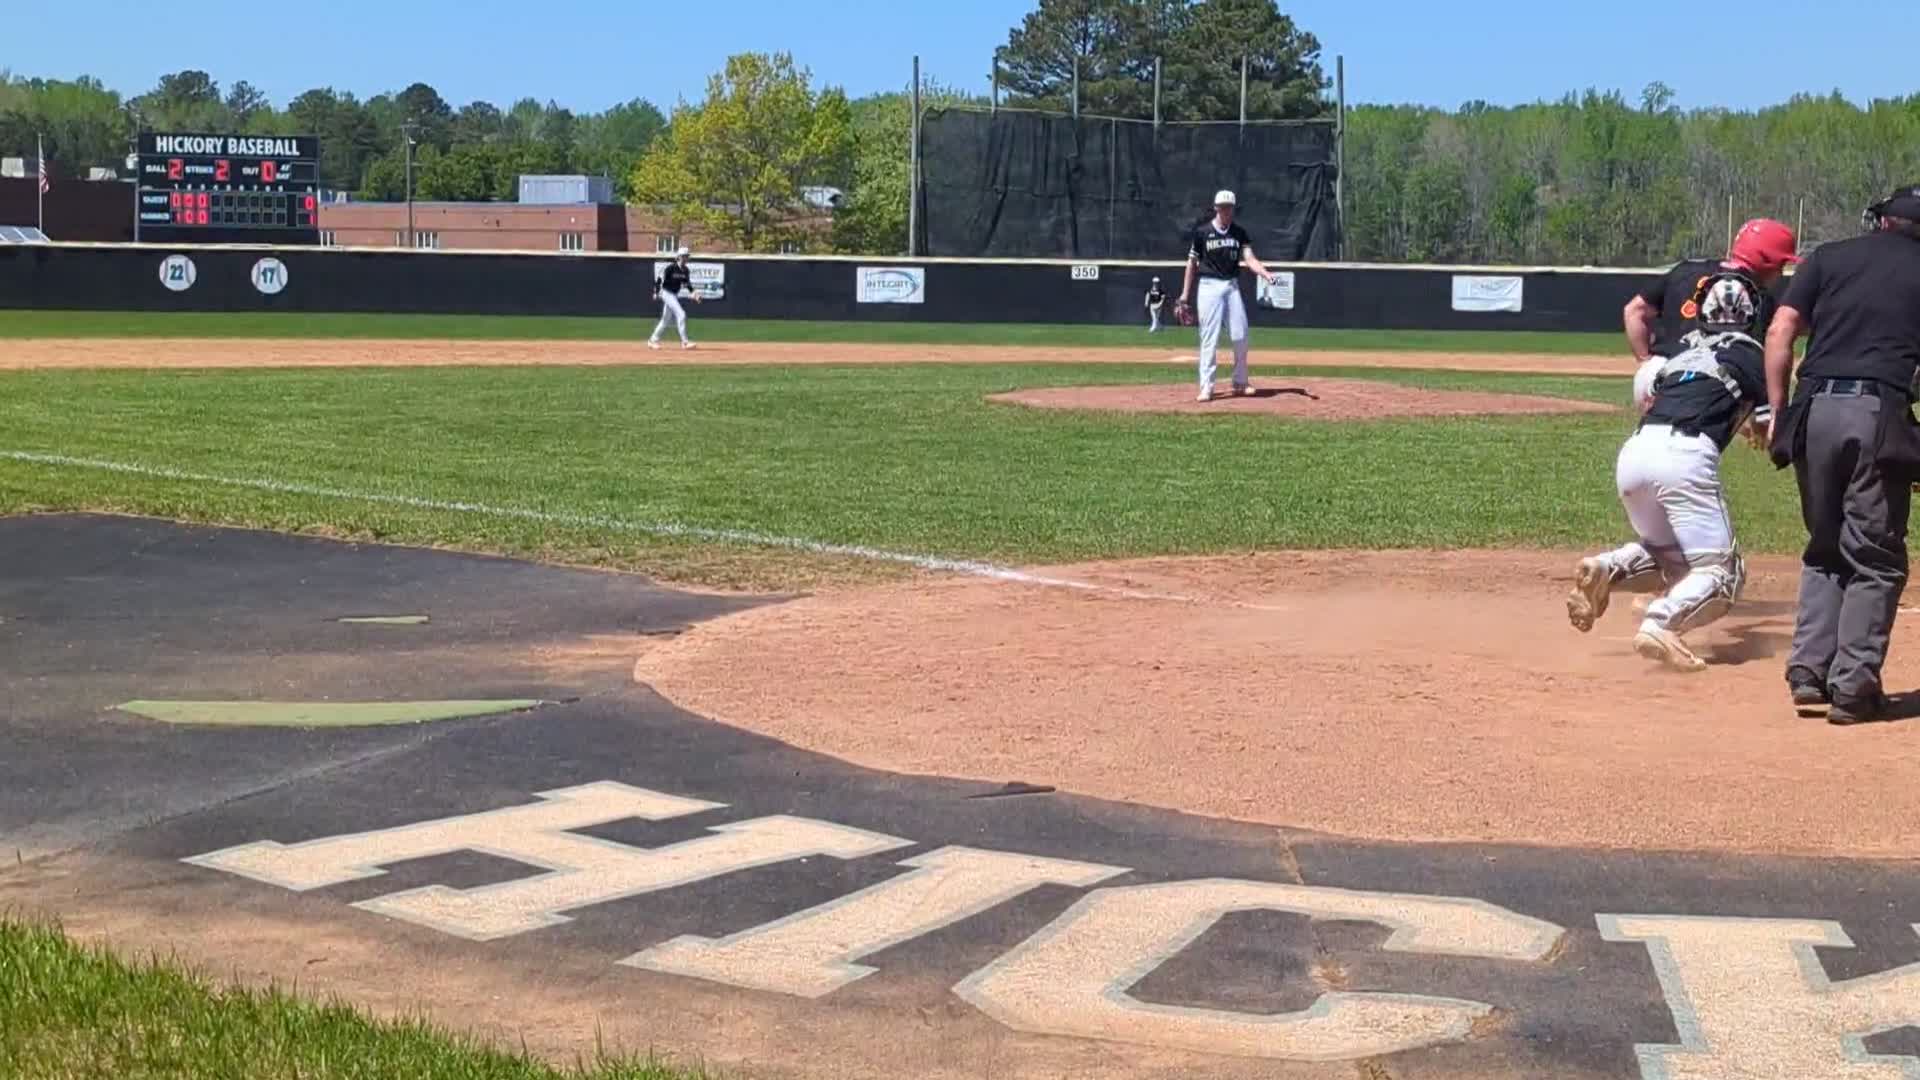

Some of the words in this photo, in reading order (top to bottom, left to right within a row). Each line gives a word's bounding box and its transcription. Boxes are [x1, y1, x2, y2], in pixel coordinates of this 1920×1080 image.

[156, 135, 224, 153] HICKORY
[227, 138, 300, 156] BASEBALL
[168, 159, 184, 179] 2
[215, 160, 230, 181] 2
[261, 161, 275, 182] 0
[169, 264, 185, 281] 22
[261, 267, 276, 284] 17
[1074, 266, 1097, 278] 350
